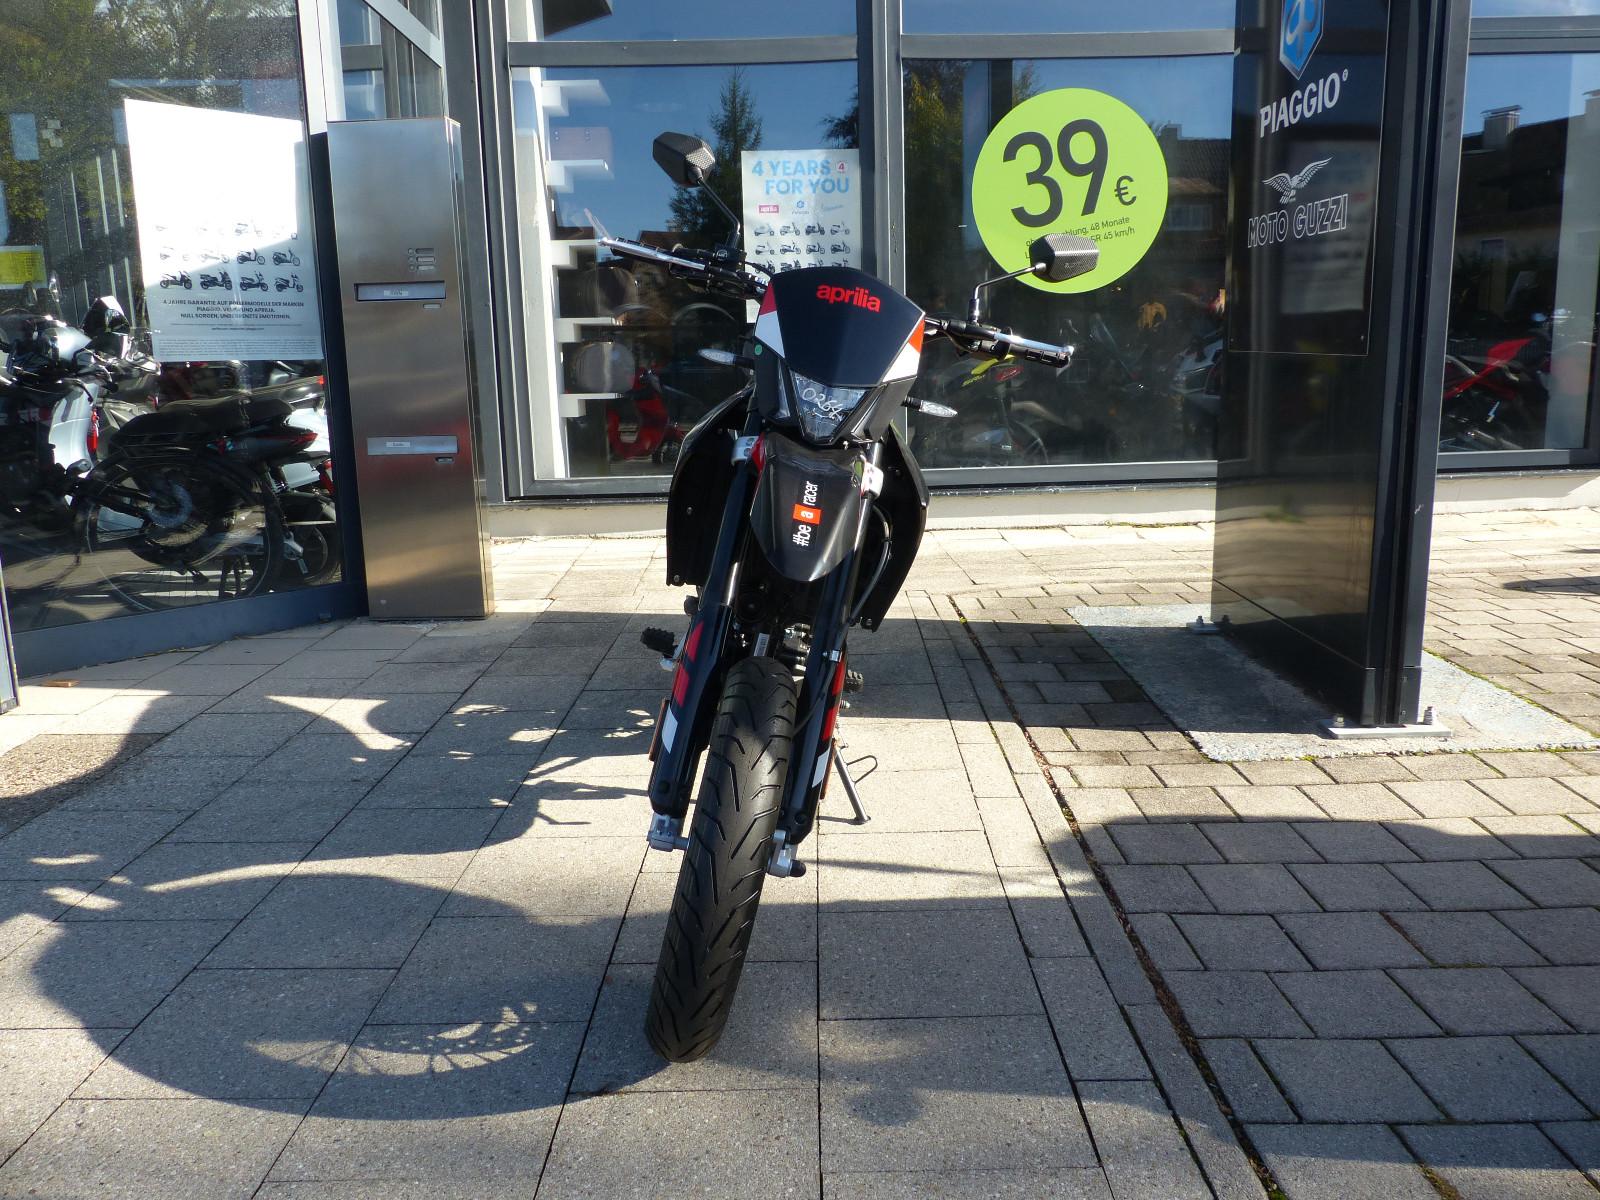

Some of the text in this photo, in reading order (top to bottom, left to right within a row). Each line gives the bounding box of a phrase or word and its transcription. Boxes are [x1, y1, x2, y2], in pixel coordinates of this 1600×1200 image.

[752, 160, 832, 176] 4 YEARS
[1002, 118, 1137, 228] 39 €
[765, 176, 849, 195] FOR YOU
[1090, 222, 1100, 231] 48
[1102, 216, 1130, 229] Monate
[1247, 193, 1349, 248] MOTO GUZZI
[1103, 231, 1112, 240] 45
[1114, 226, 1135, 238] km/h
[816, 283, 882, 313] aprilia
[792, 480, 819, 547] #be a racer
